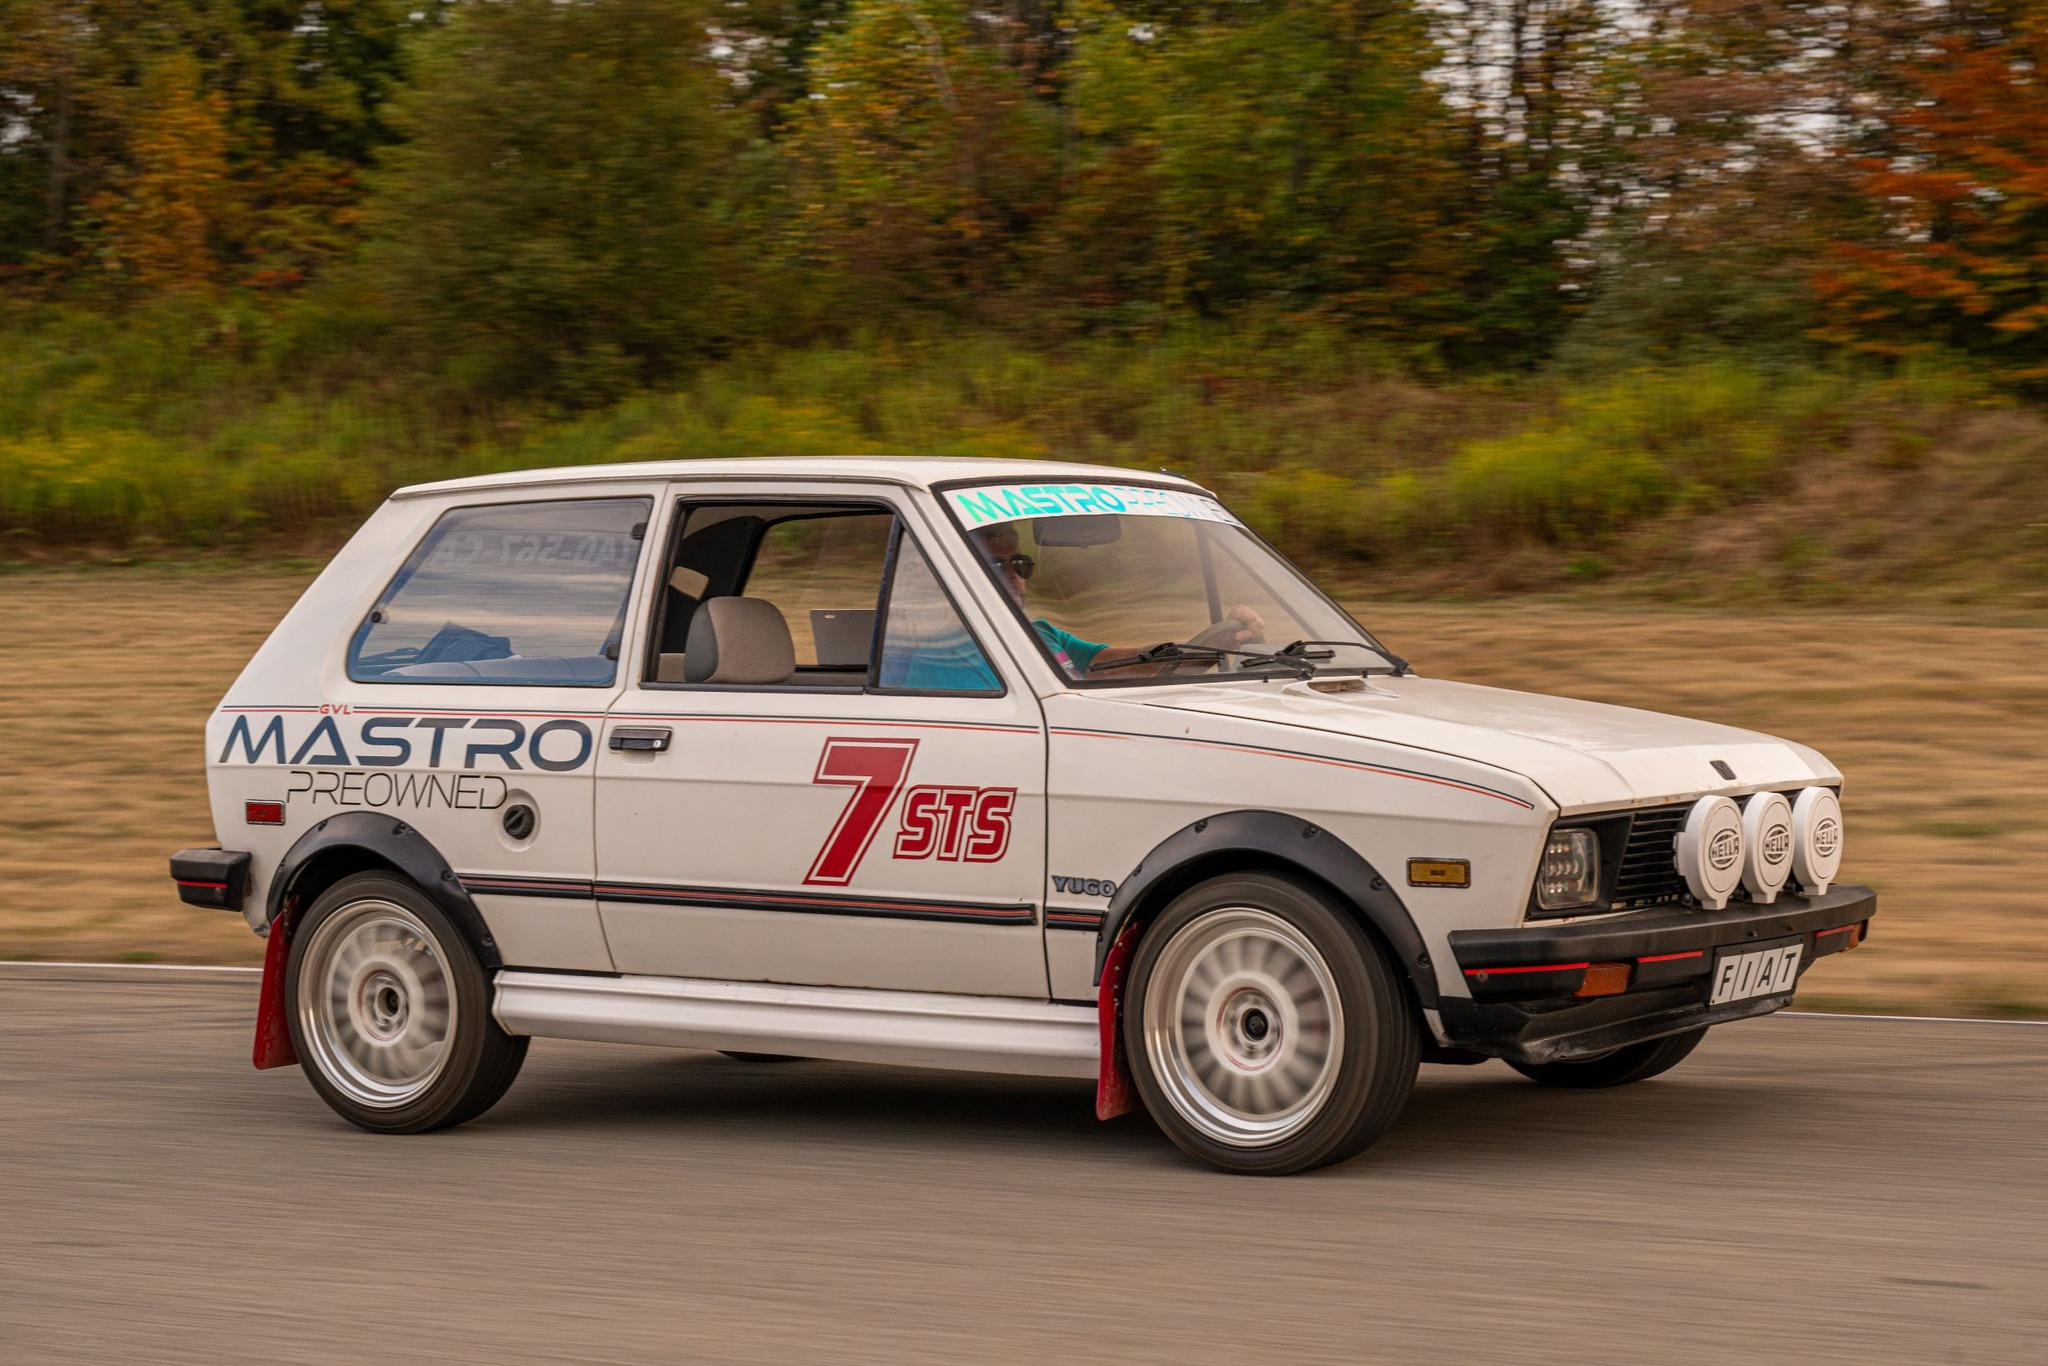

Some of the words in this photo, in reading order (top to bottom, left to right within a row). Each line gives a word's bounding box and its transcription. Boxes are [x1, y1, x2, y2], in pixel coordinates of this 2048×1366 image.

[956, 486, 1127, 523] MASTRO
[319, 704, 351, 715] GVL
[219, 715, 592, 771] MASTRO
[286, 771, 508, 810] PREOWNED
[801, 736, 921, 887] 7
[892, 784, 1018, 863] STS
[1711, 835, 1740, 859] HELLA
[1765, 833, 1790, 853] HELLA
[1815, 826, 1839, 846] HELLA
[1051, 875, 1117, 898] YUGO
[1718, 952, 1797, 997] FIAT
